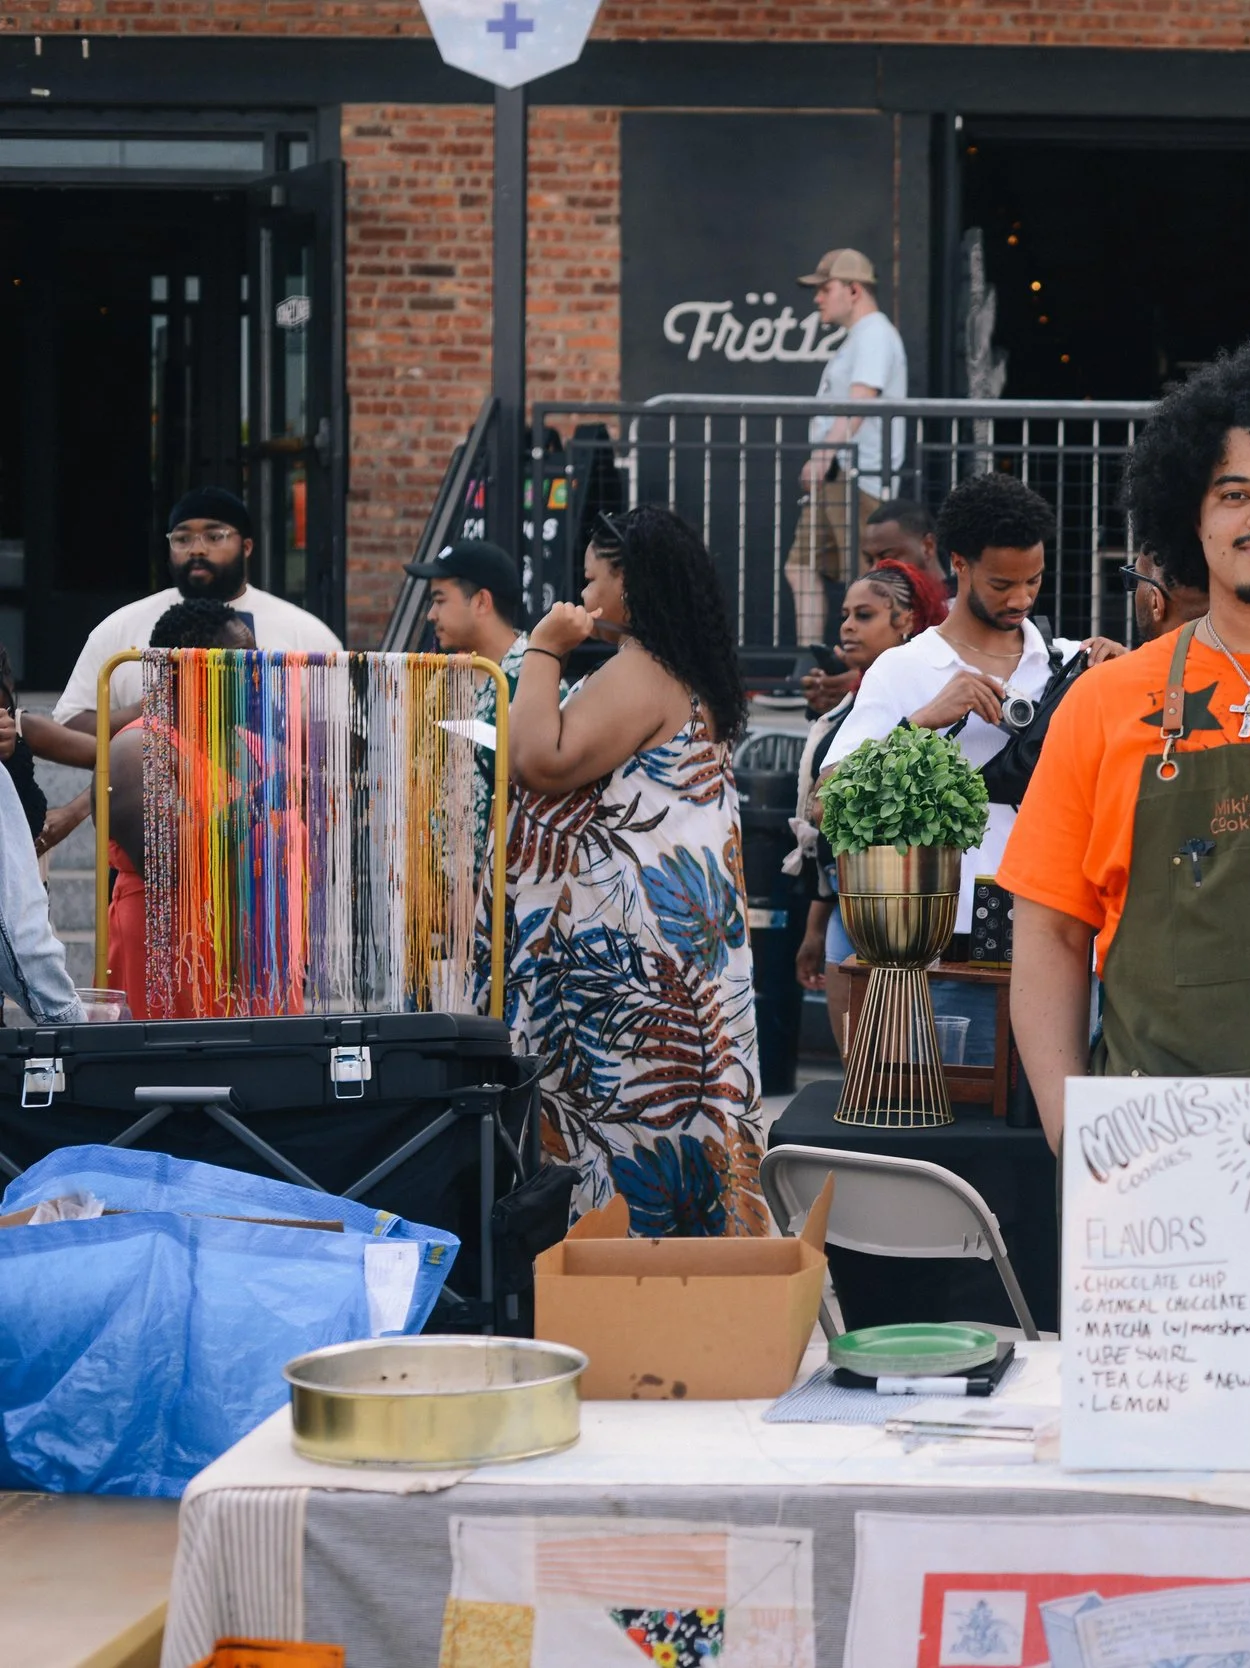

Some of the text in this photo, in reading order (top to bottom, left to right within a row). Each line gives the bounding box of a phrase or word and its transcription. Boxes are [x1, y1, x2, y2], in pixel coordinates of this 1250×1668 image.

[1086, 1216, 1207, 1260] FLAVORS
[1188, 1271, 1227, 1290] CHIP
[1081, 1298, 1159, 1315] OATMEAL
[1084, 1319, 1152, 1338] MATCHA
[1086, 1344, 1198, 1365] UBE SWIRL
[1091, 1371, 1130, 1389] TEA
[1137, 1372, 1190, 1393] CAKE
[1091, 1394, 1170, 1413] LEMON
